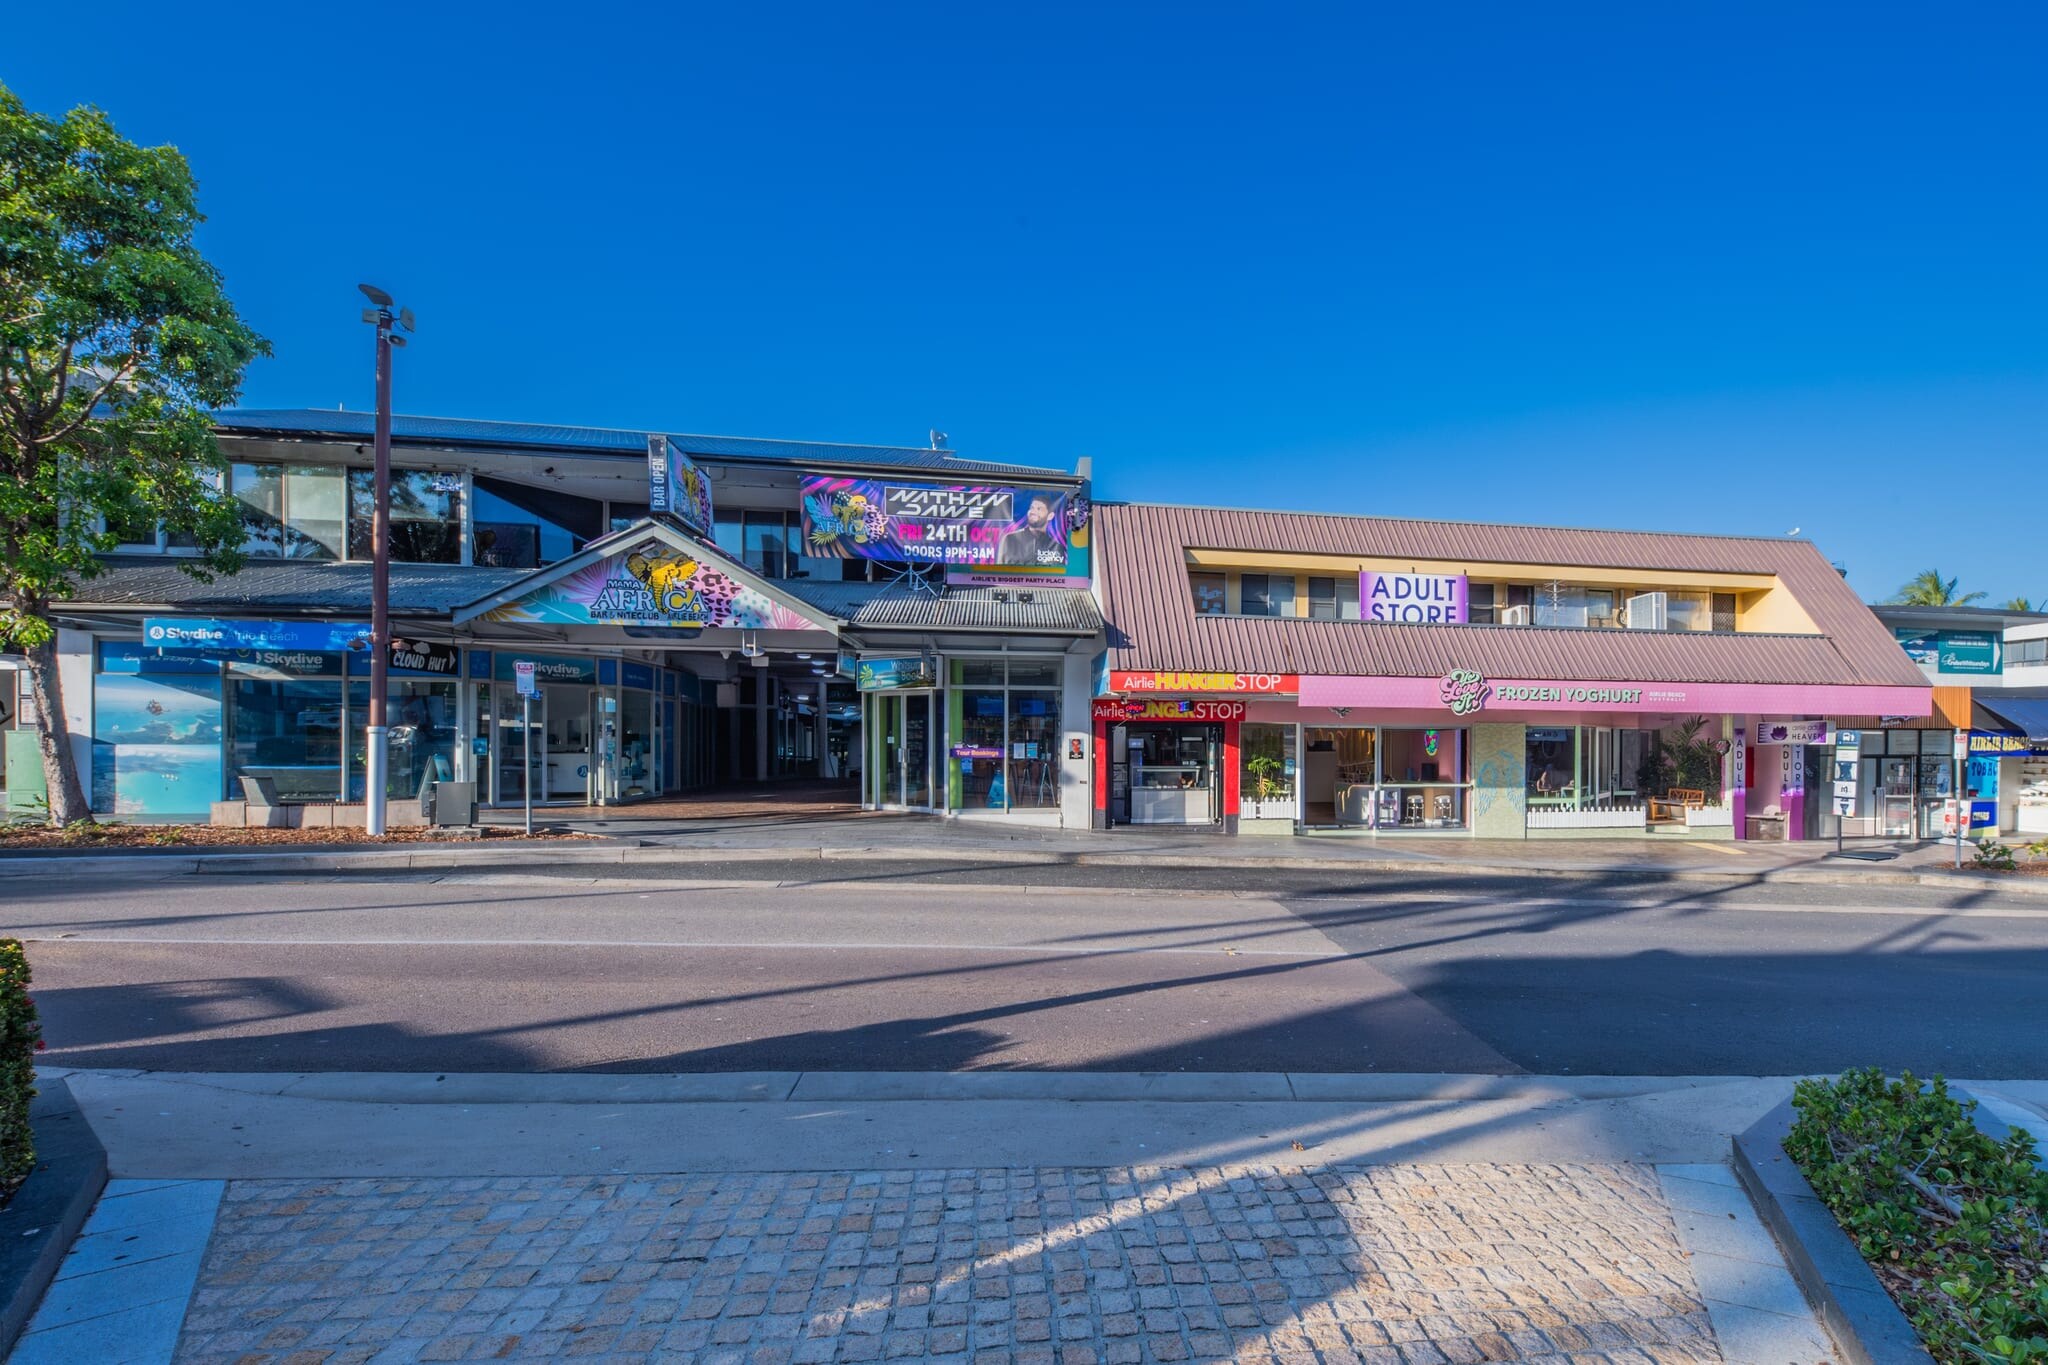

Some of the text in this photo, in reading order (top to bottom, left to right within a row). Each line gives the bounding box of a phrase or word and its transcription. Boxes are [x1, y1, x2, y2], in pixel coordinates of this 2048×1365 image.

[651, 458, 666, 506] BAR OPEN
[888, 489, 1010, 506] NATHAN
[896, 503, 984, 518] DAWE
[898, 523, 1001, 543] FRI 24TH OCT
[903, 544, 995, 559] DOORS 9PM-3AM
[606, 579, 641, 589] MAMA
[1371, 575, 1457, 602] ADULT
[590, 611, 608, 619] BAR
[616, 611, 660, 620] NITECLUB
[687, 613, 709, 621] BEACH
[1371, 602, 1457, 623] STORE
[165, 627, 224, 641] Skydive
[260, 630, 299, 641] Beach
[263, 652, 324, 666] Skydive
[392, 651, 448, 672] CLOUD HUT
[532, 661, 581, 675] Skydive
[1123, 673, 1282, 690] Airlie HUNGER STOP
[1440, 677, 1480, 703] Love
[1495, 686, 1643, 704] FROZEN YOGHURT
[1094, 705, 1125, 719] Airlie
[1196, 703, 1244, 720] STOP
[1791, 732, 1824, 740] HEAVEN
[1970, 736, 2002, 751] AIRLIE
[956, 749, 999, 758] Tour Bookings
[1736, 740, 1744, 793] ADULT
